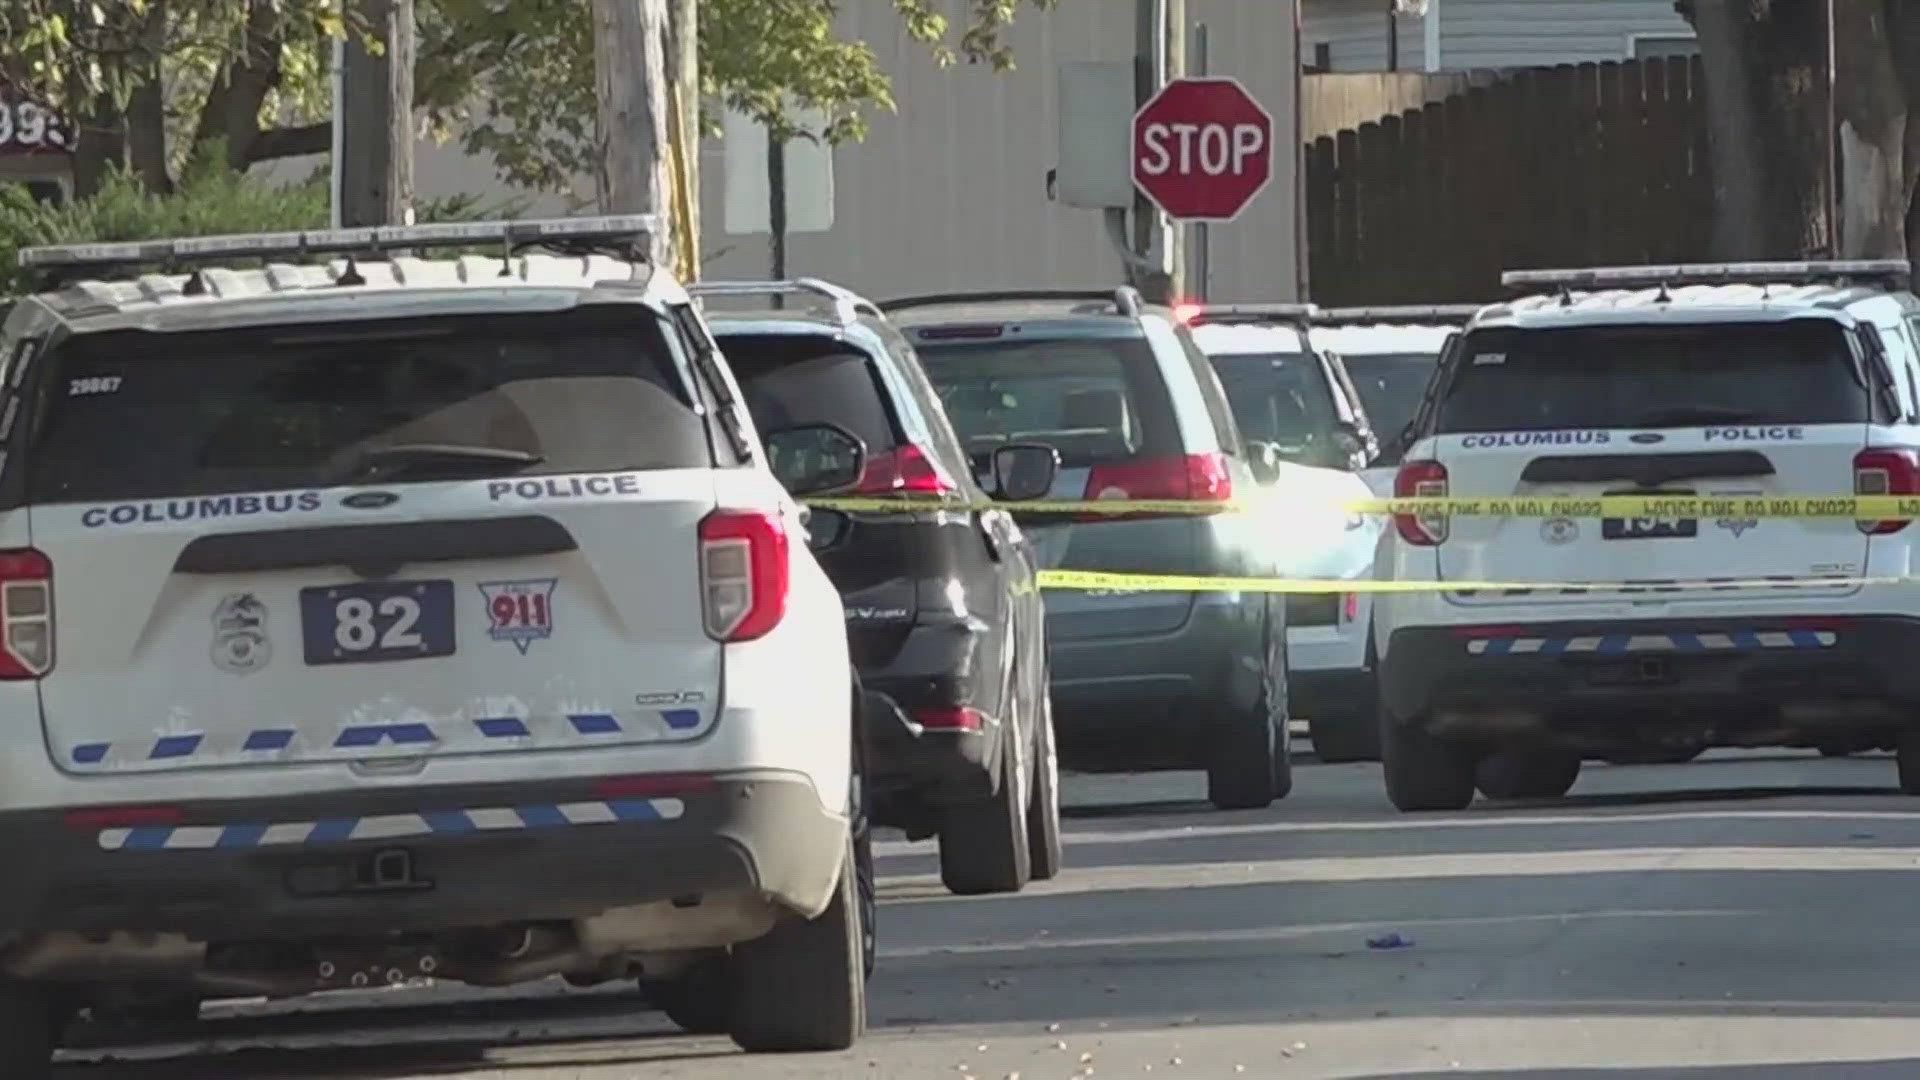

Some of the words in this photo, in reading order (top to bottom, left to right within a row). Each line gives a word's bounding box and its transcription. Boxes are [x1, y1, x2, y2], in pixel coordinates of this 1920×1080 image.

[1140, 123, 1264, 176] STOP
[1460, 428, 1612, 450] COLUMBUS
[1703, 425, 1804, 442] POLICE
[81, 491, 322, 528] COLUMBUS
[488, 475, 640, 501] POLICE
[335, 596, 422, 650] 82
[492, 593, 546, 626] 911
